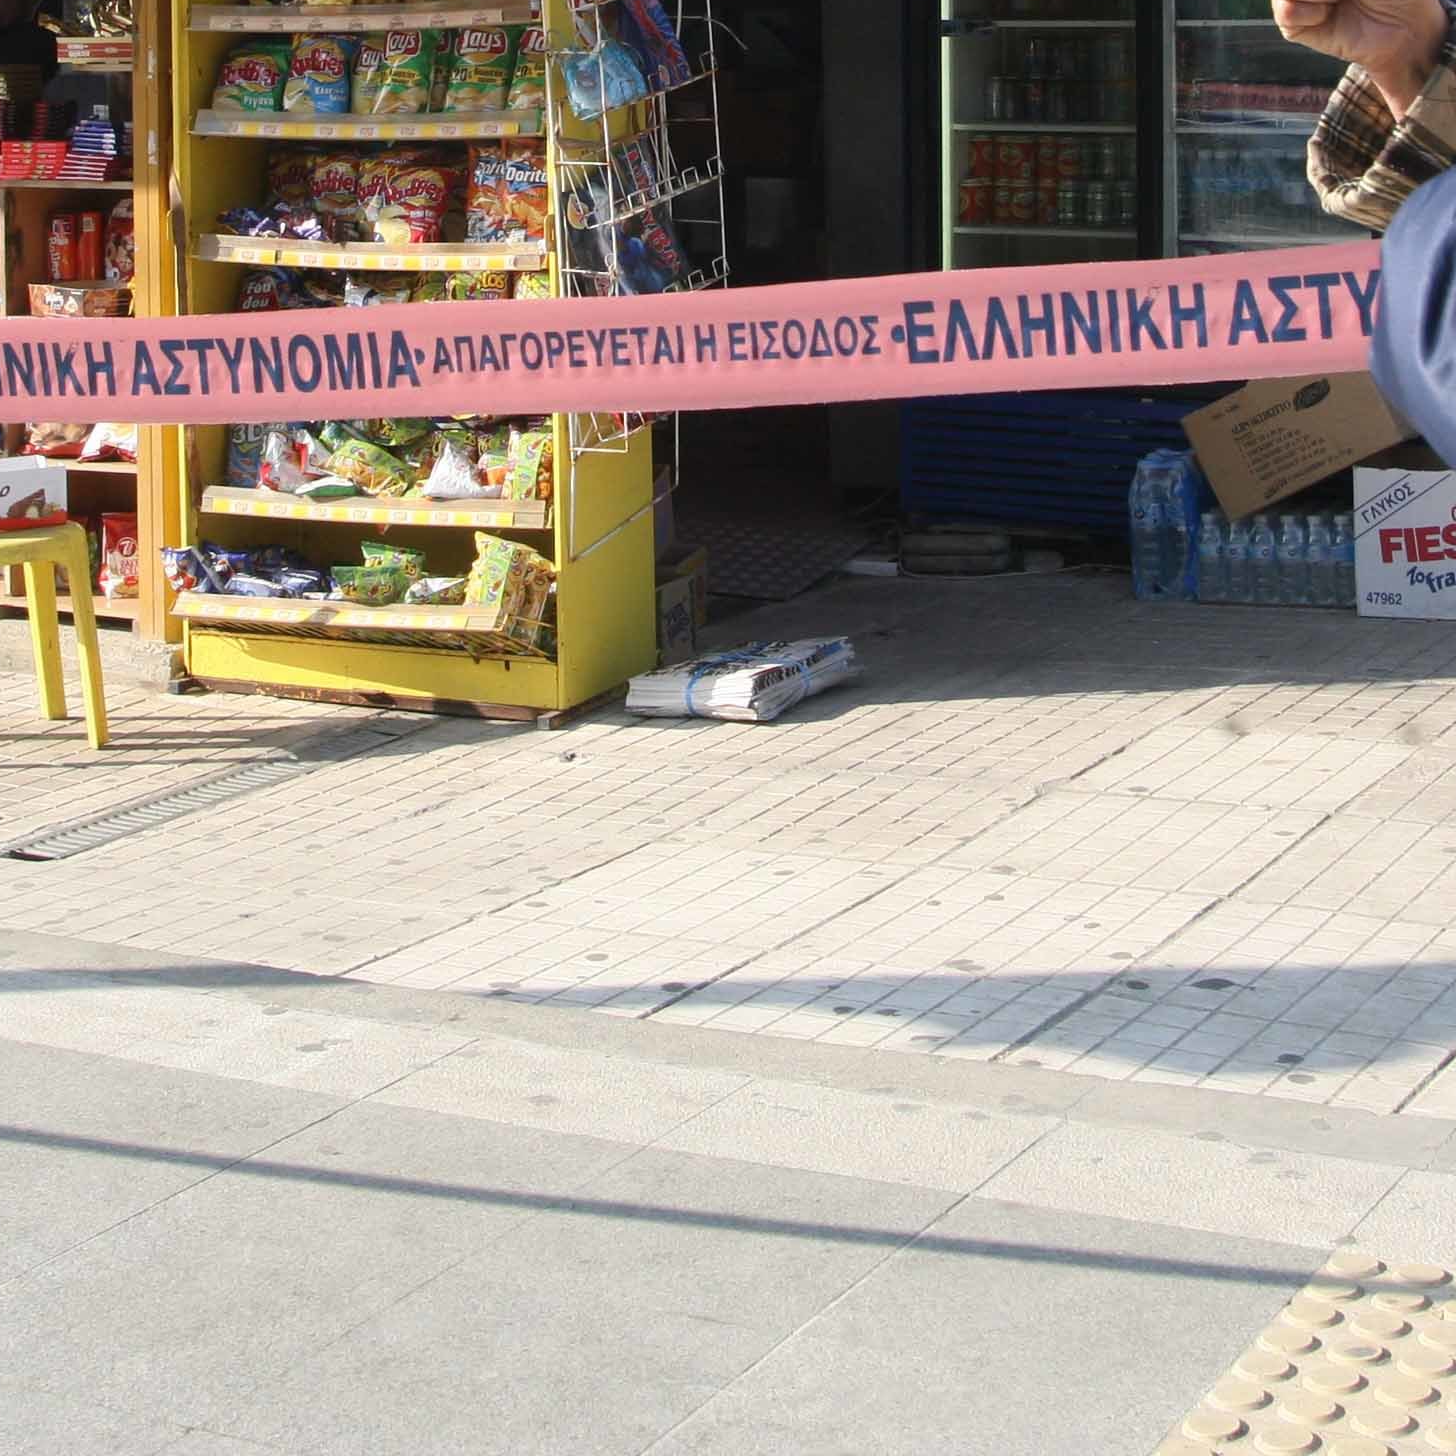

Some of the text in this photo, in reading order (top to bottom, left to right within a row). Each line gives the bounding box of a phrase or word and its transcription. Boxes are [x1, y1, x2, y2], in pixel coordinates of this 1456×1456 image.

[130, 330, 421, 396] ΑΣΤΥΝΟΜΙΑ
[432, 324, 686, 375] ΑΠΑΓΟΡΕΥΕΤΑΙ
[694, 323, 718, 363] Η
[727, 315, 881, 362] ΕΙΣΟΔΟΣ
[903, 283, 1209, 364] ΕΛΛΗΝΙΚΗ
[1361, 482, 1416, 524] ΓΛΥΚΟΣ
[1366, 593, 1403, 606] 47962
